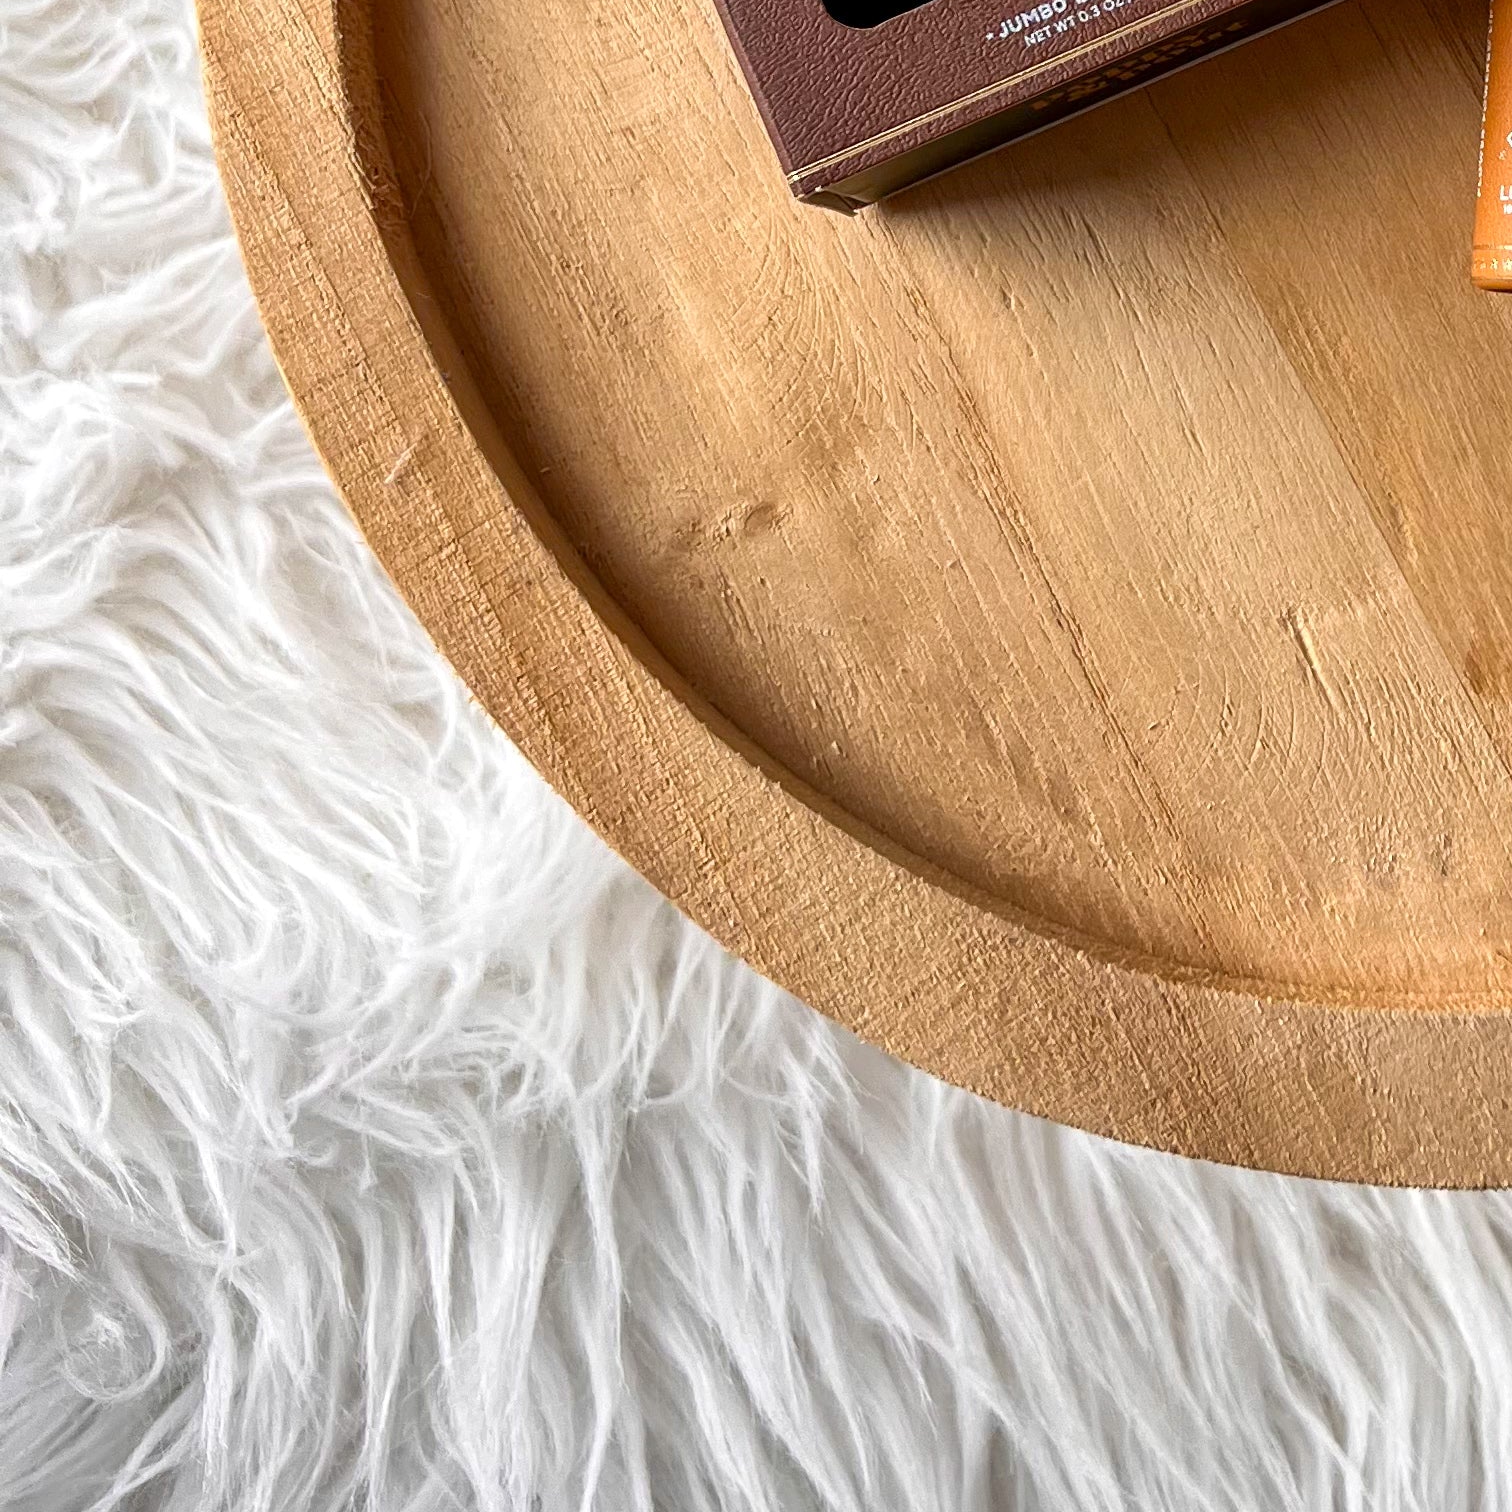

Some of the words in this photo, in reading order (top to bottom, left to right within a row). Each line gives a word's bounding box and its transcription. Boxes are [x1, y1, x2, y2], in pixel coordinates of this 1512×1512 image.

[1024, 27, 1051, 47] NET
[1054, 15, 1075, 33] WT
[1078, 5, 1100, 22] 0.3
